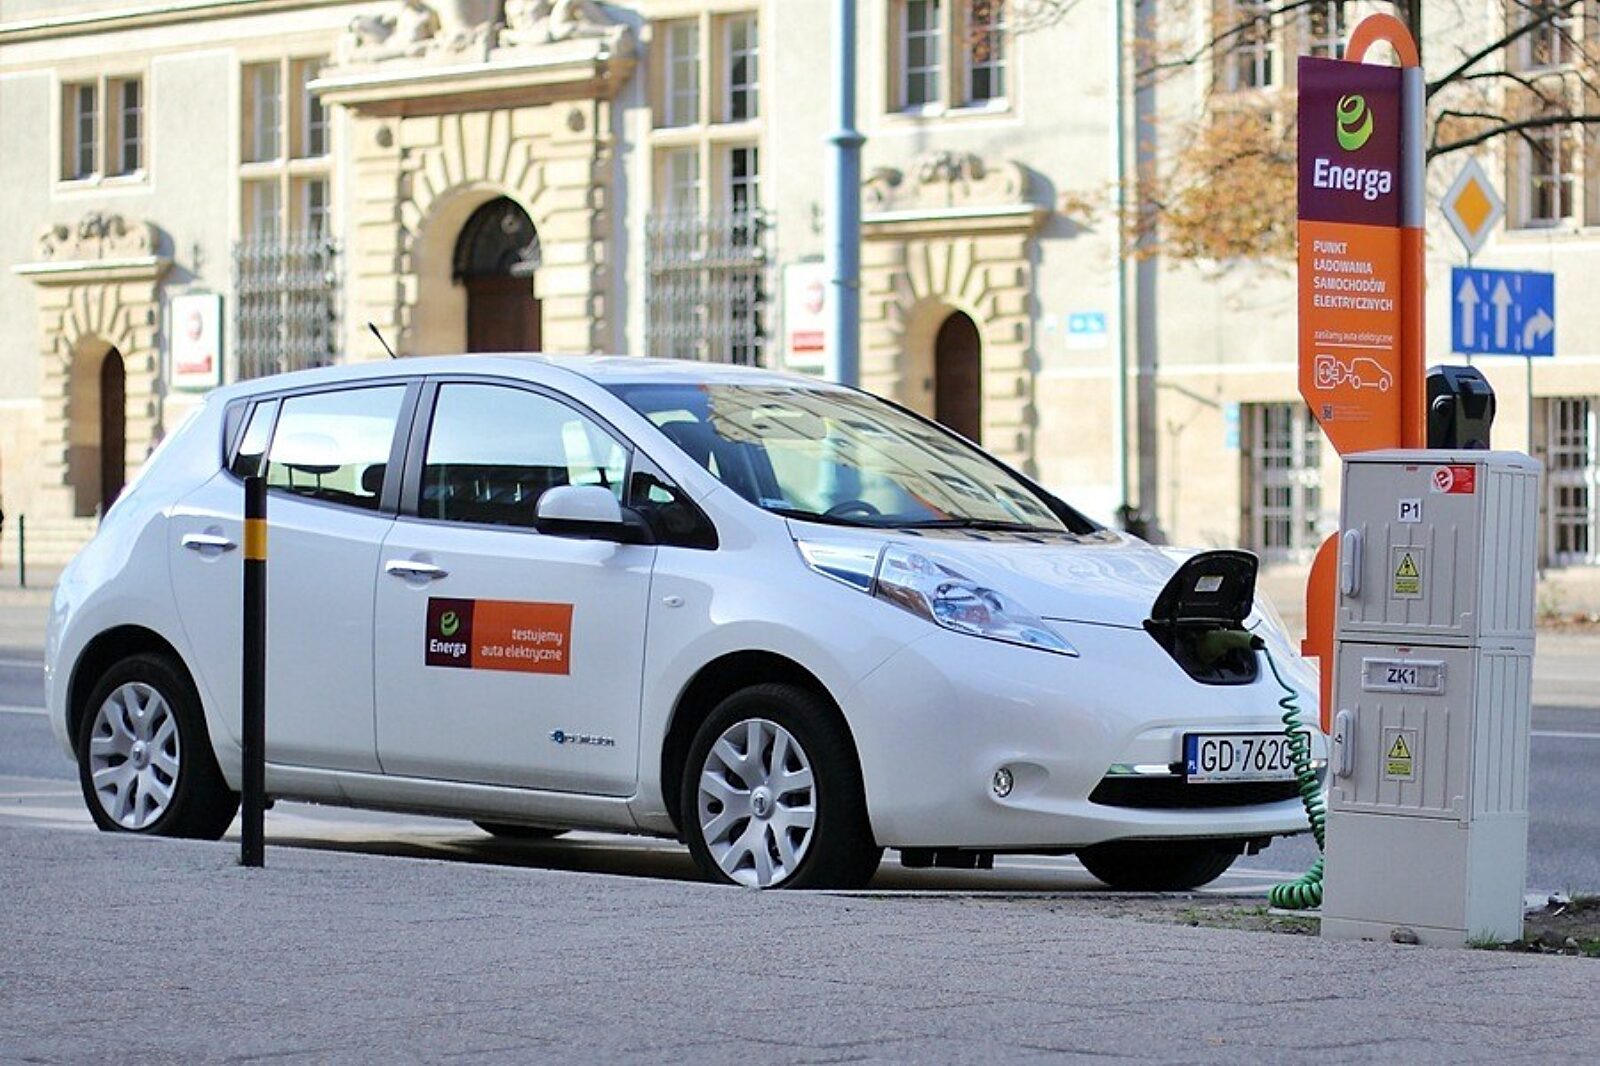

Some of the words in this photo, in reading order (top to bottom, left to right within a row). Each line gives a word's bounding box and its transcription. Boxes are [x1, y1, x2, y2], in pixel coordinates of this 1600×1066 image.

[1314, 158, 1392, 200] Energa
[1313, 240, 1348, 254] PUNKT
[1313, 258, 1373, 275] ŁADOWANIA
[1313, 276, 1386, 293] SAMOCHODÓW
[1313, 294, 1393, 311] ELEKTRYCZNYCH
[1400, 503, 1420, 518] P1
[511, 628, 563, 645] testujemy
[429, 639, 467, 658] Energa
[481, 644, 504, 657] auta
[505, 645, 562, 663] elektryczne
[1387, 668, 1416, 684] ZK1
[1201, 740, 1234, 772] GD
[1242, 739, 1303, 771] 762G
